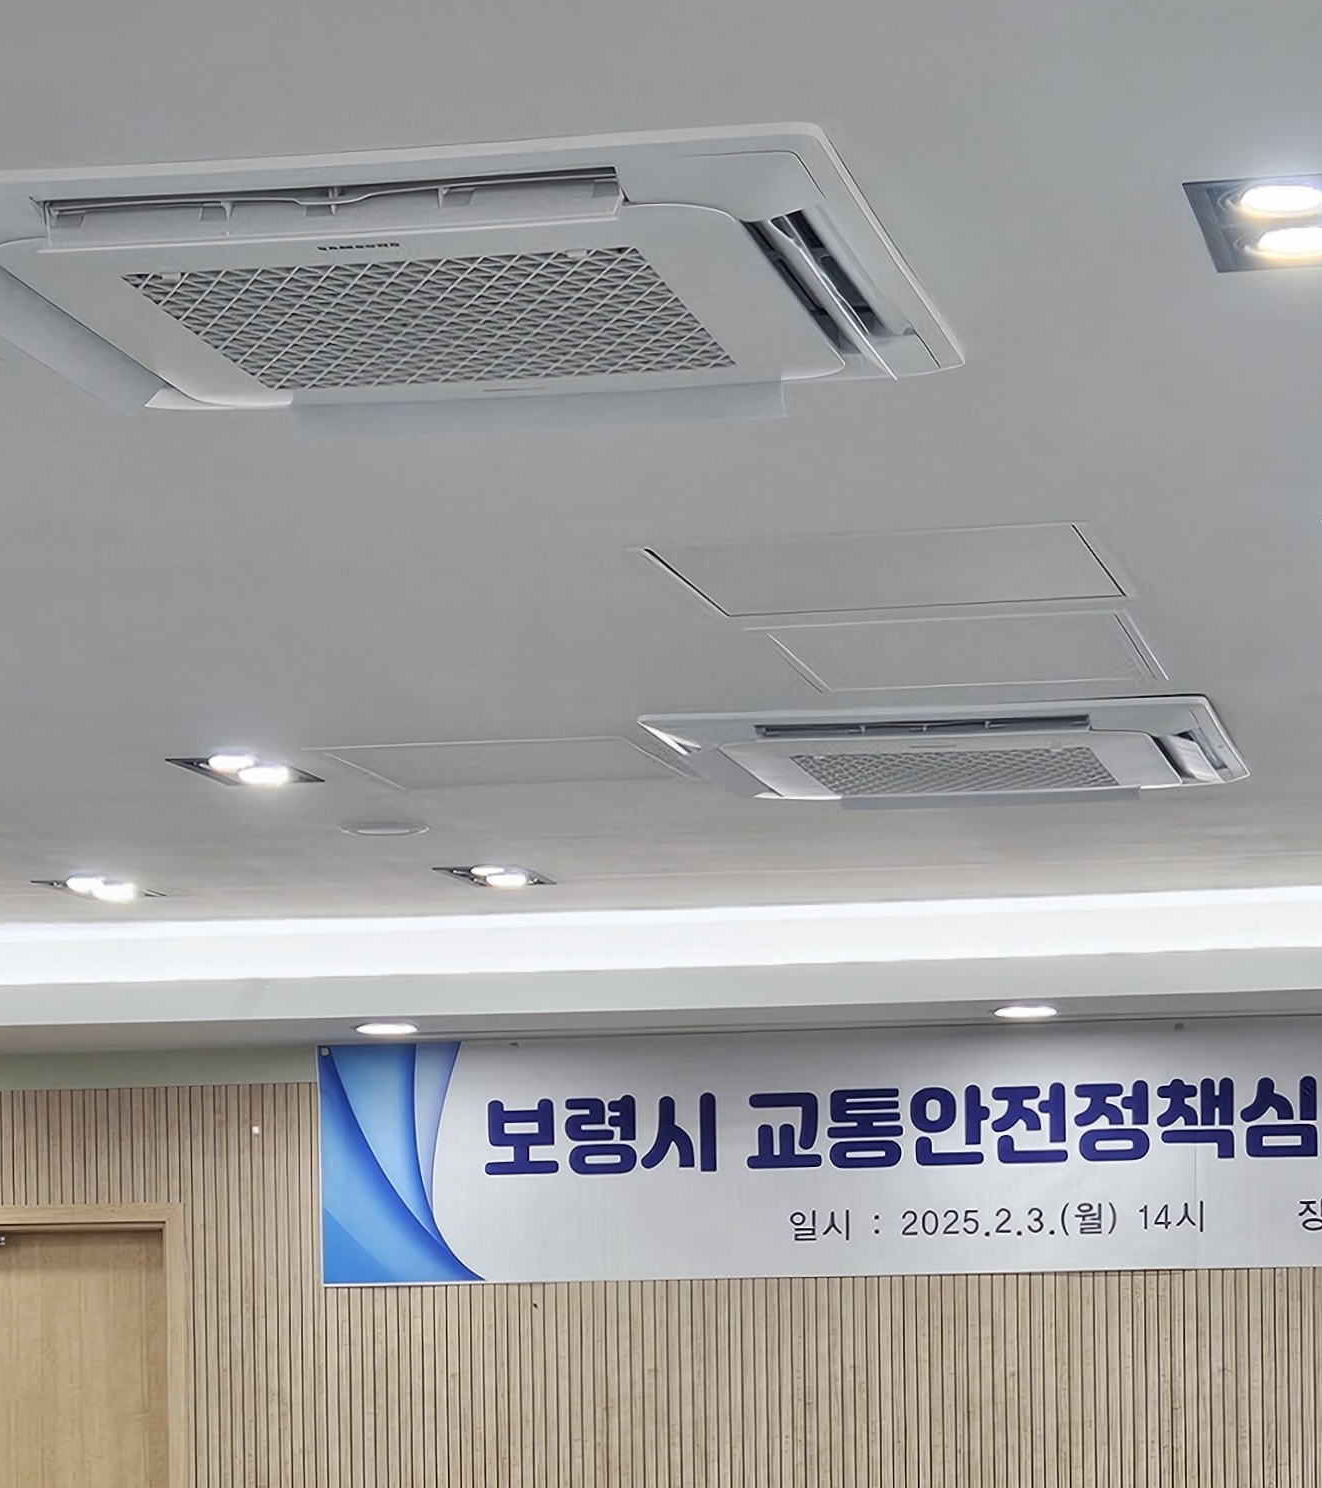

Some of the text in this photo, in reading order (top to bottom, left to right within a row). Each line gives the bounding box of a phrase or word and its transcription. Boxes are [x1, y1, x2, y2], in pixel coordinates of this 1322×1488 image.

[484, 1092, 718, 1175] 보령시
[789, 1208, 851, 1242] 일시
[901, 1202, 1118, 1238] 2025.2.3.(월)
[1138, 1200, 1205, 1233] 14시
